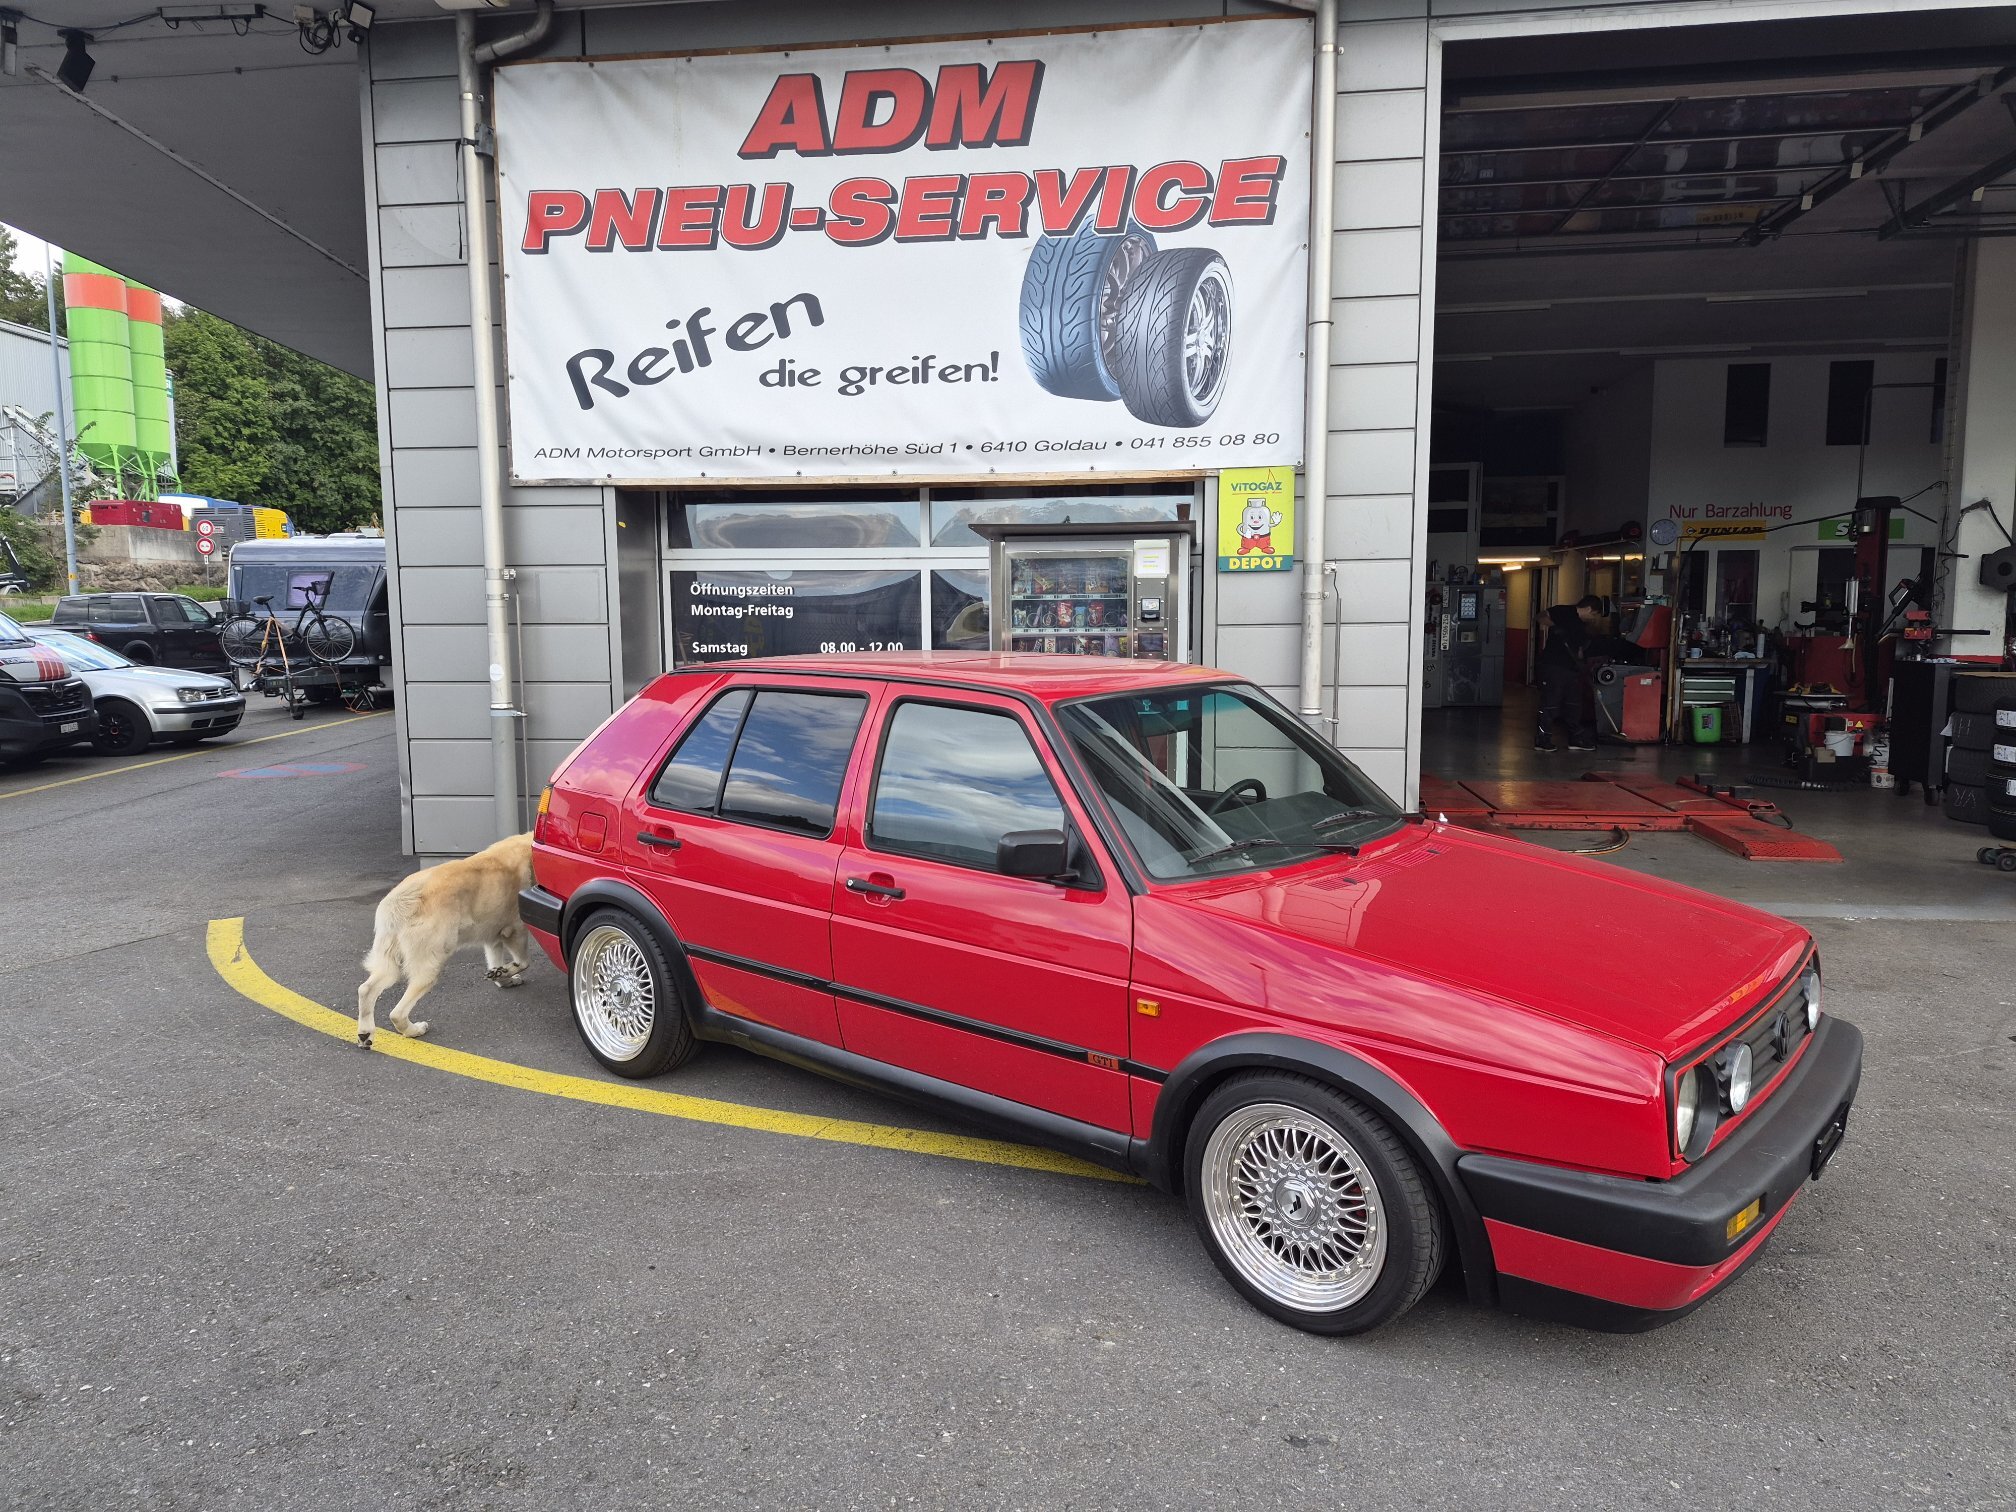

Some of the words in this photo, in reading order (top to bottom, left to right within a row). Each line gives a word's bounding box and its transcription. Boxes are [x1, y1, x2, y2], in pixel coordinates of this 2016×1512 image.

[737, 58, 1046, 160] ADM
[521, 154, 1288, 256] PNEU-SERVICE
[565, 292, 825, 411] Reifen
[758, 358, 822, 388] die
[837, 350, 1000, 397] greifen!
[534, 446, 580, 459] ADM
[586, 446, 693, 460] Motorsport
[699, 444, 761, 457] GmbH
[783, 442, 898, 457] Bernerhöhe
[904, 441, 942, 455] Süd
[949, 442, 958, 454] 1
[980, 440, 1027, 453] 6410
[1034, 439, 1107, 452] Goldau
[1130, 437, 1165, 450] 041
[1172, 435, 1211, 449] 855
[1219, 434, 1245, 447] 08
[1252, 432, 1280, 445] 80
[1669, 504, 1698, 519] Nur
[1705, 503, 1793, 520] Barzahlung
[1228, 556, 1284, 570] DEPOT
[690, 581, 794, 598] Öffnungszeiten
[690, 603, 794, 618] Montag-Freitag
[692, 641, 748, 656] Samstag
[1092, 1054, 1114, 1068] GTI
